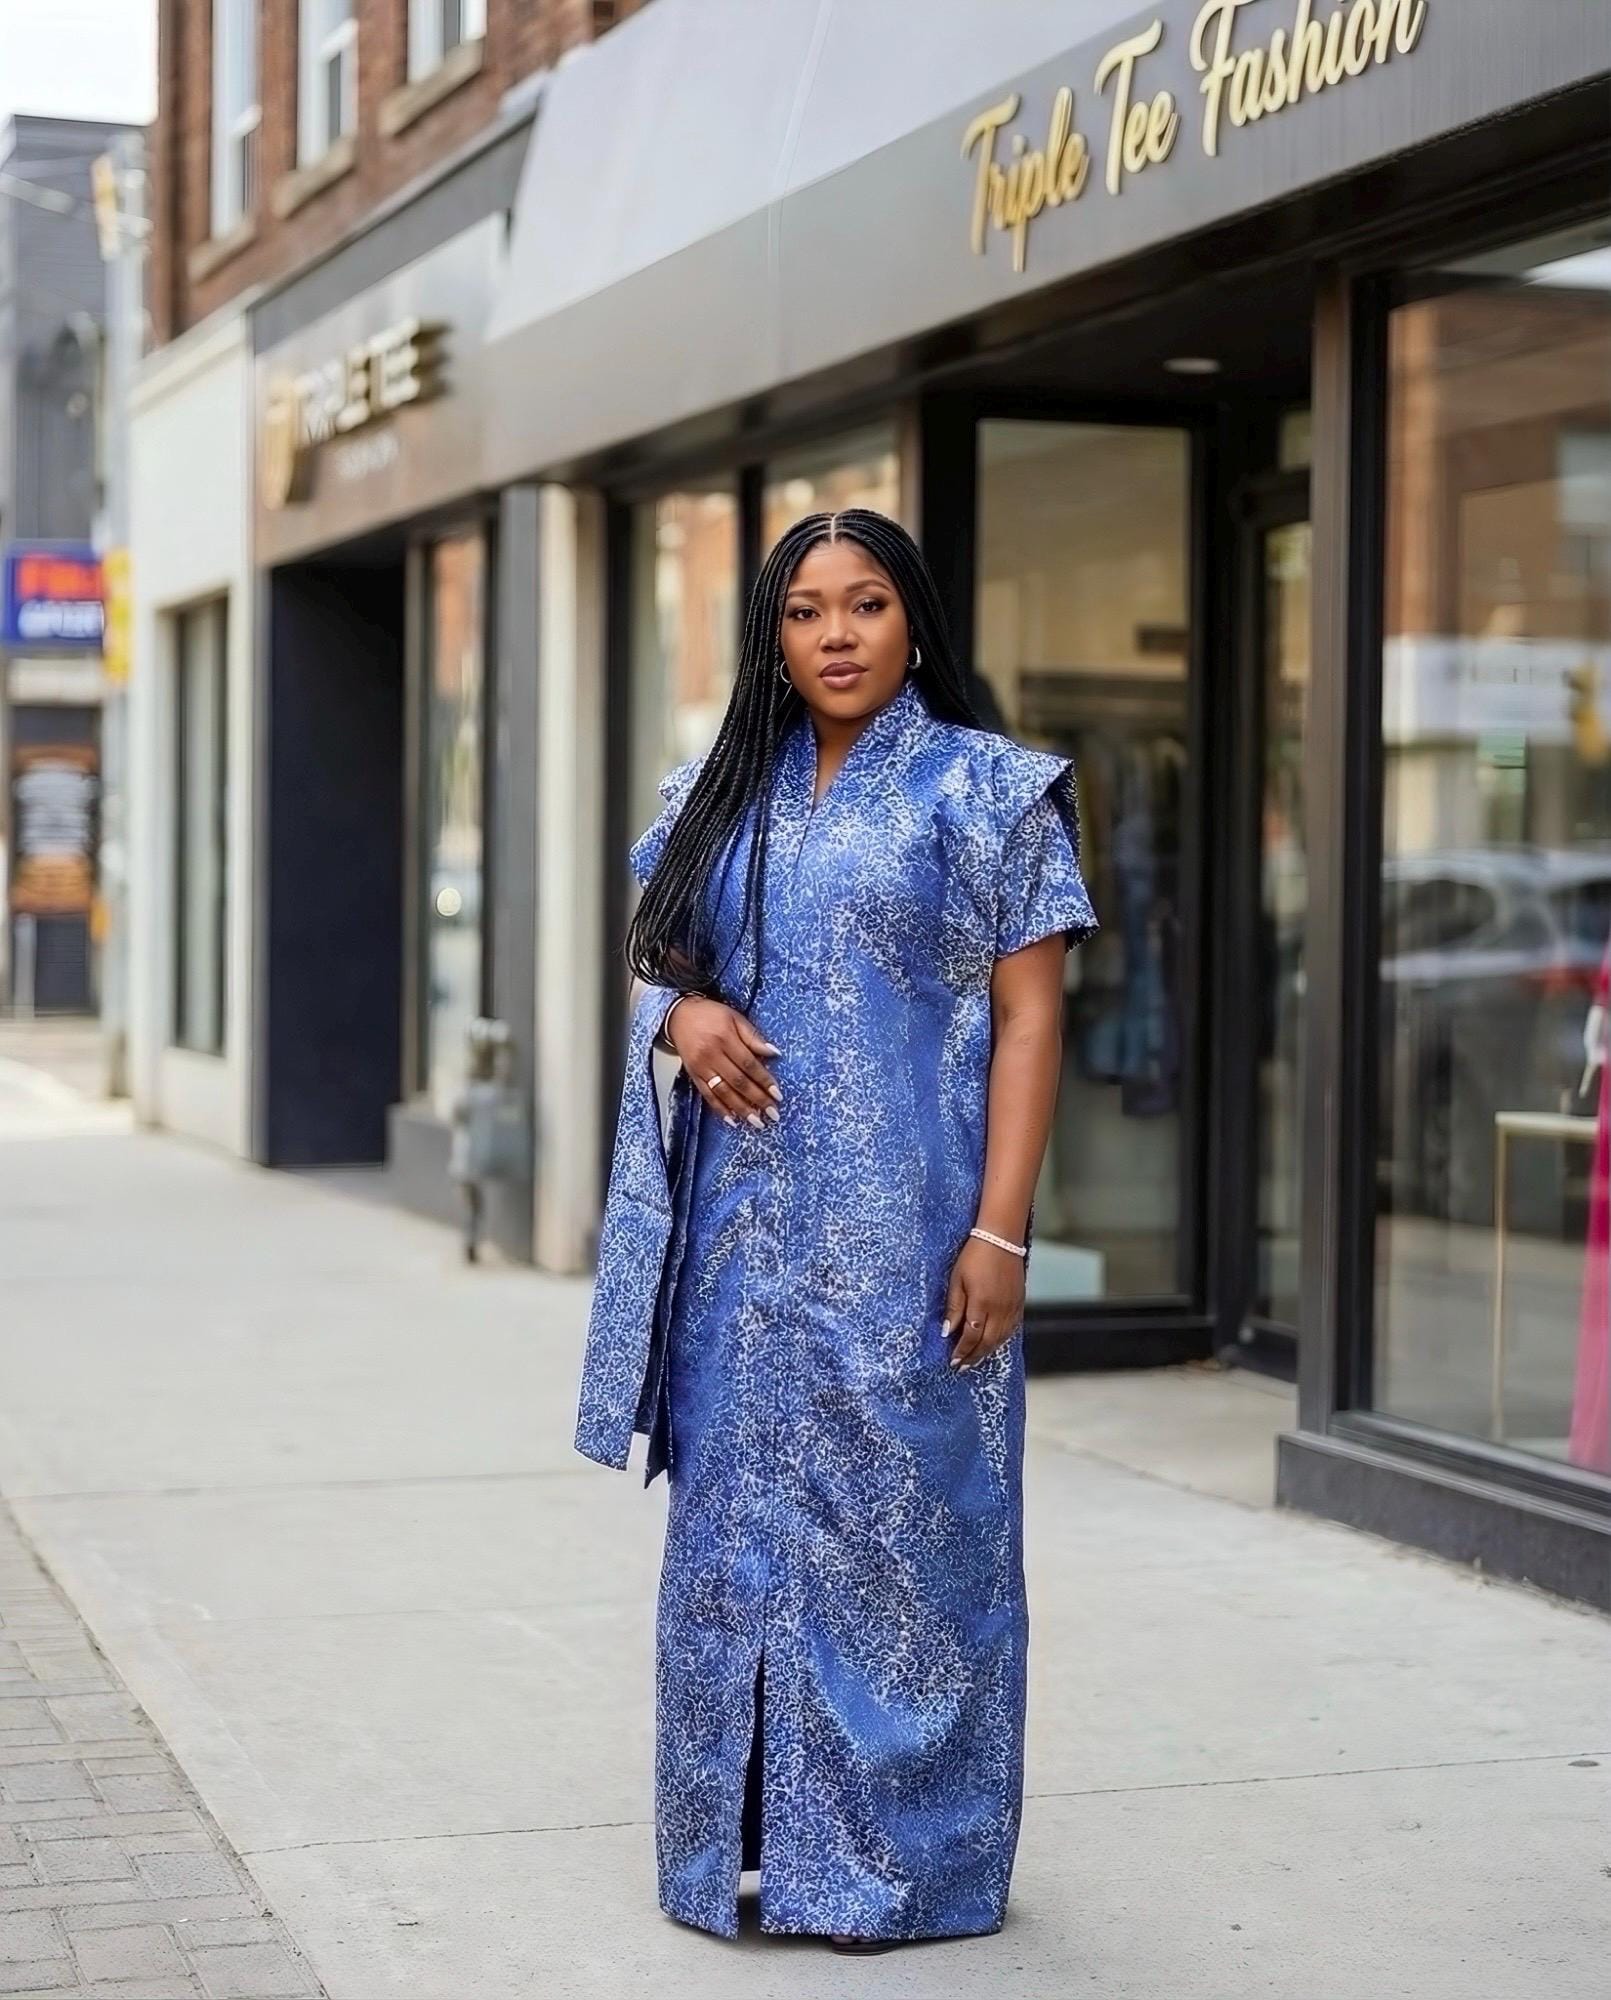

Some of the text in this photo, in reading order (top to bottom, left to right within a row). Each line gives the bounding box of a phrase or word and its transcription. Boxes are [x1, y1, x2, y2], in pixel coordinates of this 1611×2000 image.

[961, 0, 1426, 272] Triple Tee Fashion
